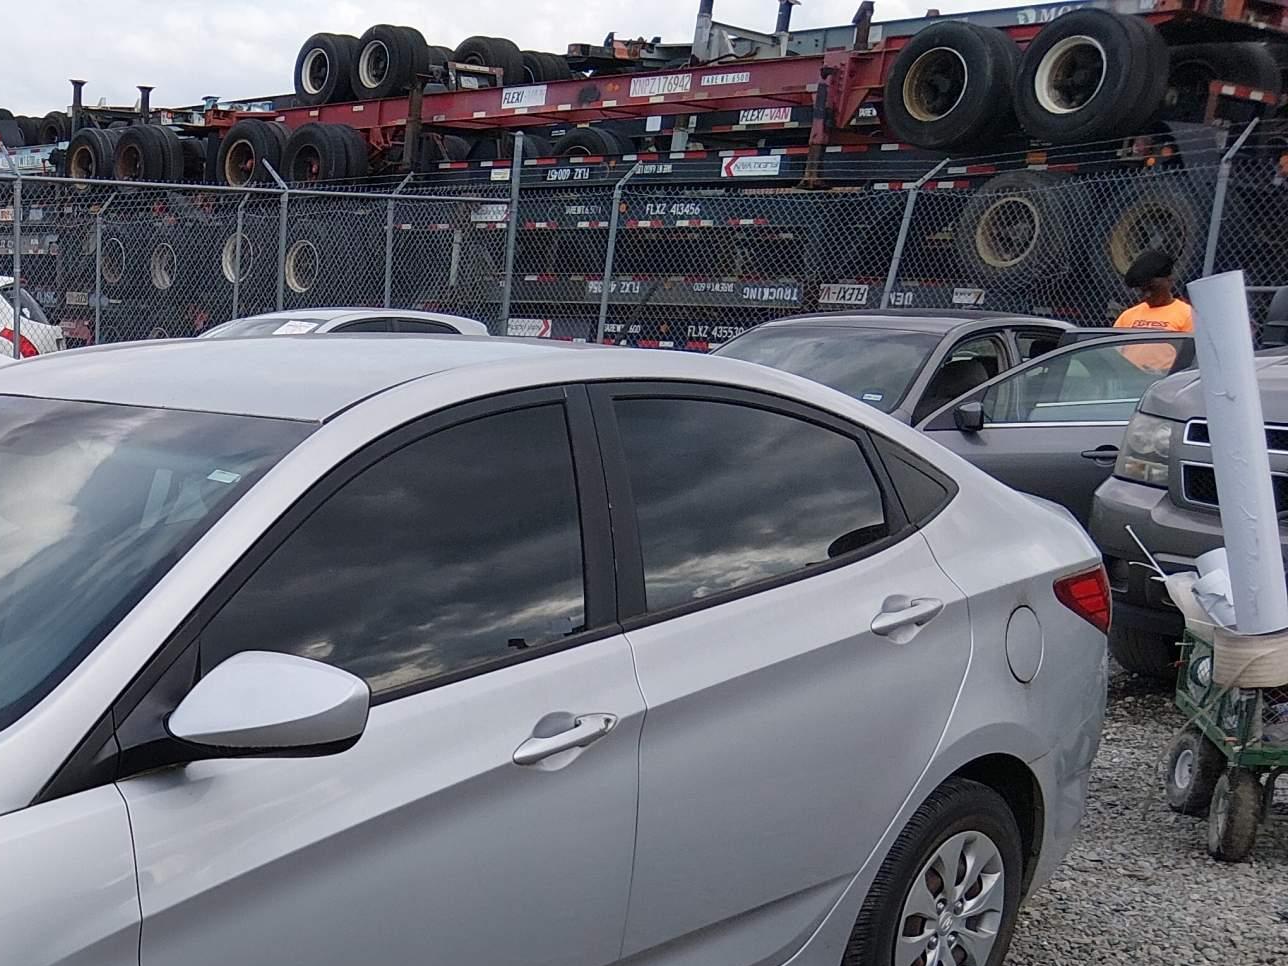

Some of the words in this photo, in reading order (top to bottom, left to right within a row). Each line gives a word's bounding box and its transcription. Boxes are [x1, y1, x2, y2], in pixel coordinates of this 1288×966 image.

[632, 75, 691, 95] XNPZ176942
[740, 108, 789, 123] FLEXI-VAN
[645, 203, 666, 214] FLXZ
[742, 286, 799, 301] TRUCKING
[687, 325, 709, 337] FLXZ
